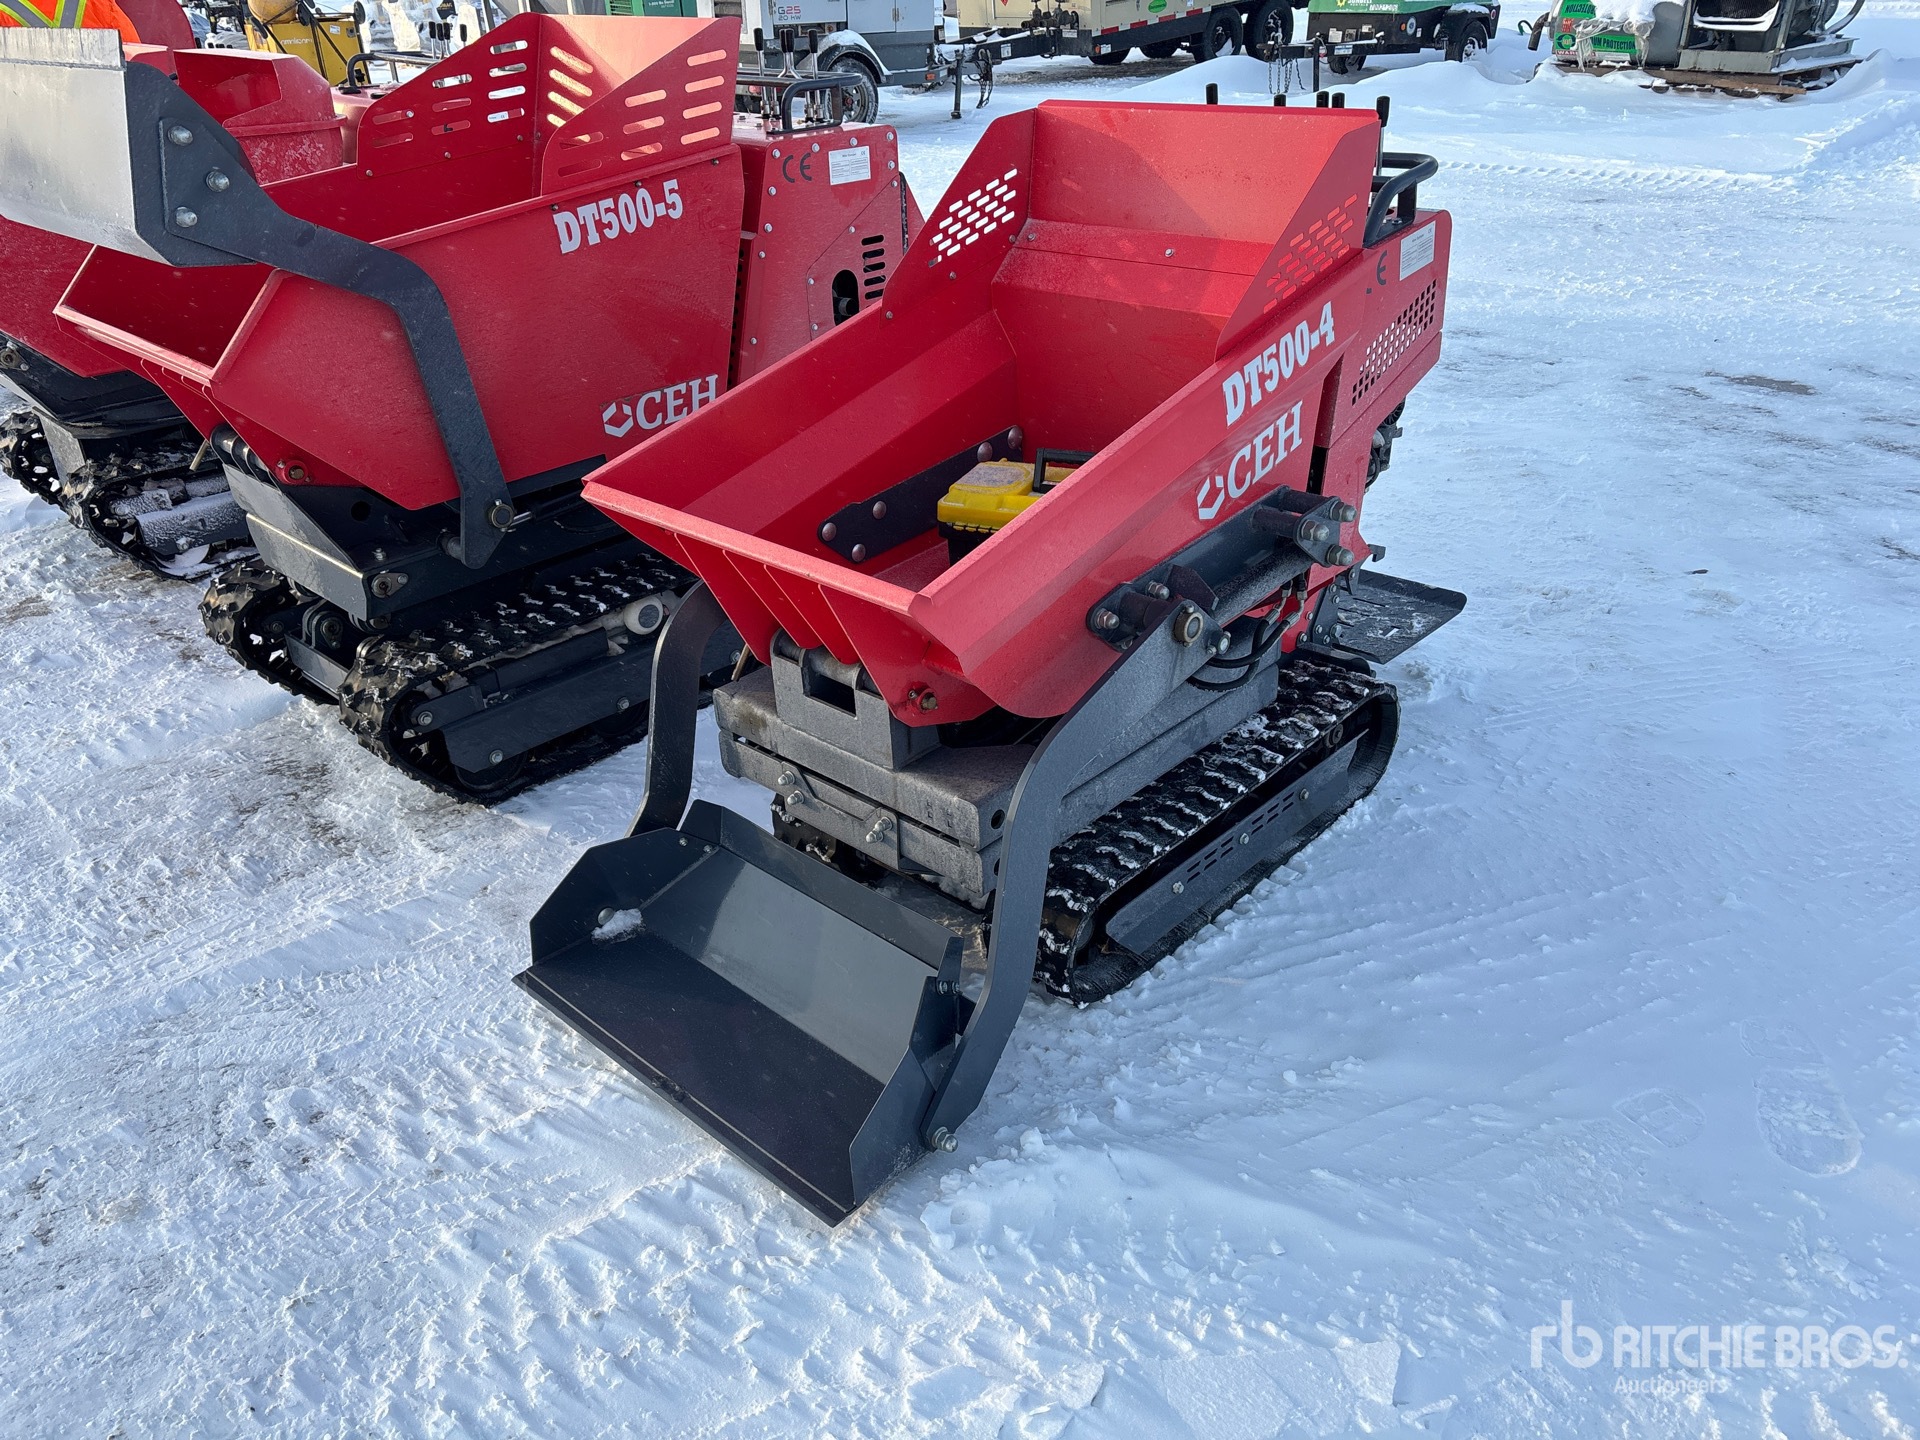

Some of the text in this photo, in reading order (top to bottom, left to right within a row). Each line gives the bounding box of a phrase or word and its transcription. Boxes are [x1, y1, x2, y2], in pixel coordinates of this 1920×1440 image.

[778, 6, 801, 15] G25
[553, 178, 683, 254] DT500-5
[636, 374, 718, 430] CEH
[1222, 301, 1335, 427] DT500-4
[1227, 400, 1303, 498] CEH
